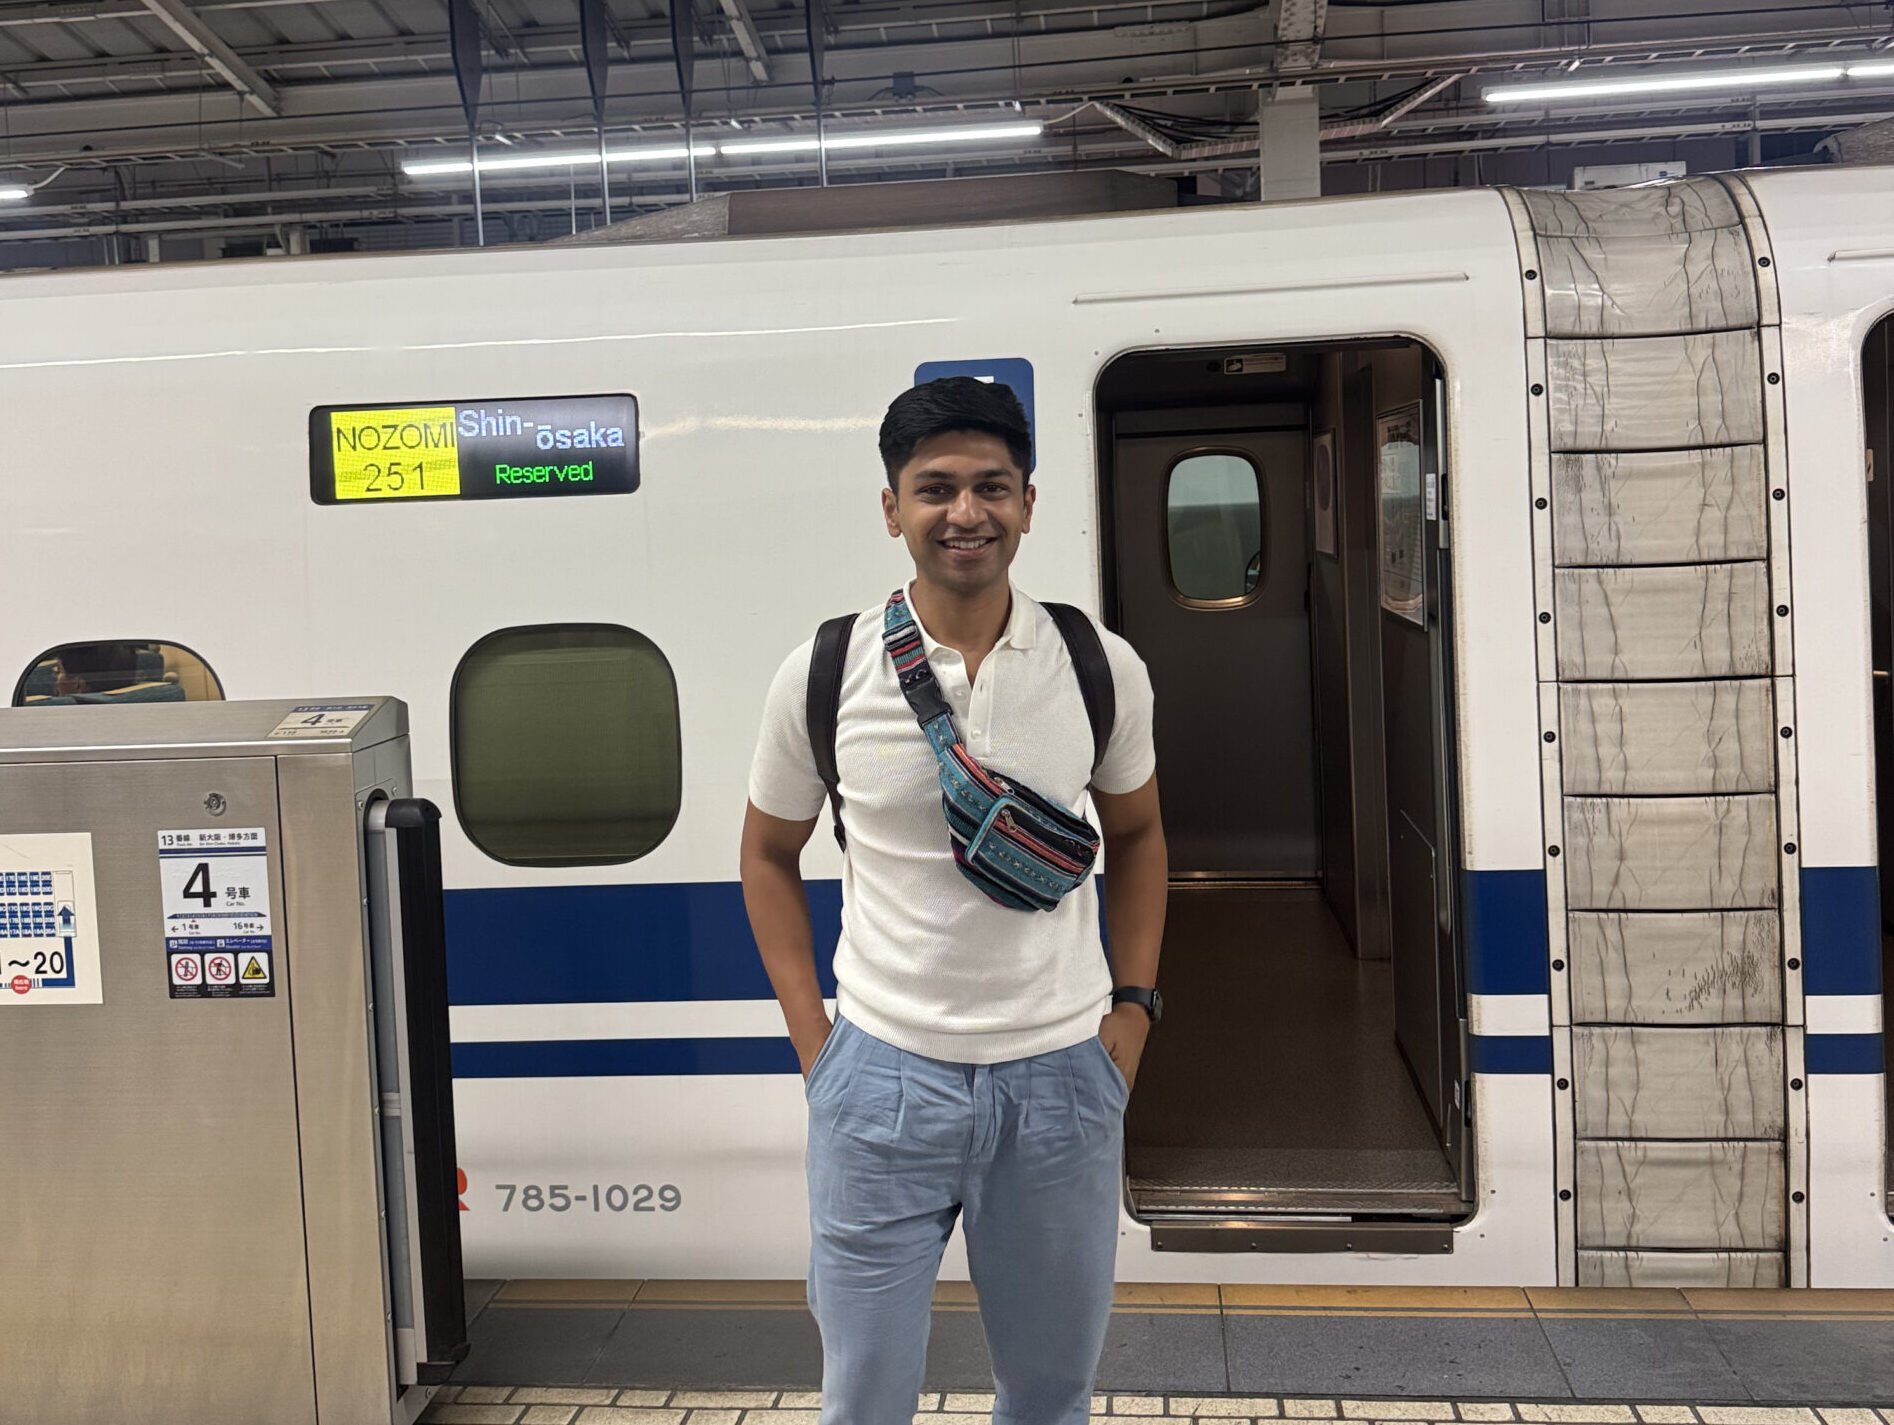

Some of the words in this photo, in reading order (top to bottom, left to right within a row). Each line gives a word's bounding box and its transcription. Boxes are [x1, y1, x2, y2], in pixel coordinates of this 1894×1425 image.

[336, 422, 456, 452] NOZOMI
[364, 461, 425, 492] 251
[495, 461, 593, 484] Reserved
[300, 713, 325, 726] 4
[161, 834, 174, 846] 13
[183, 863, 217, 908] 4
[225, 886, 251, 900] 号車
[182, 923, 186, 931] 1
[233, 921, 243, 930] 16
[495, 1184, 682, 1212] 785-1029
